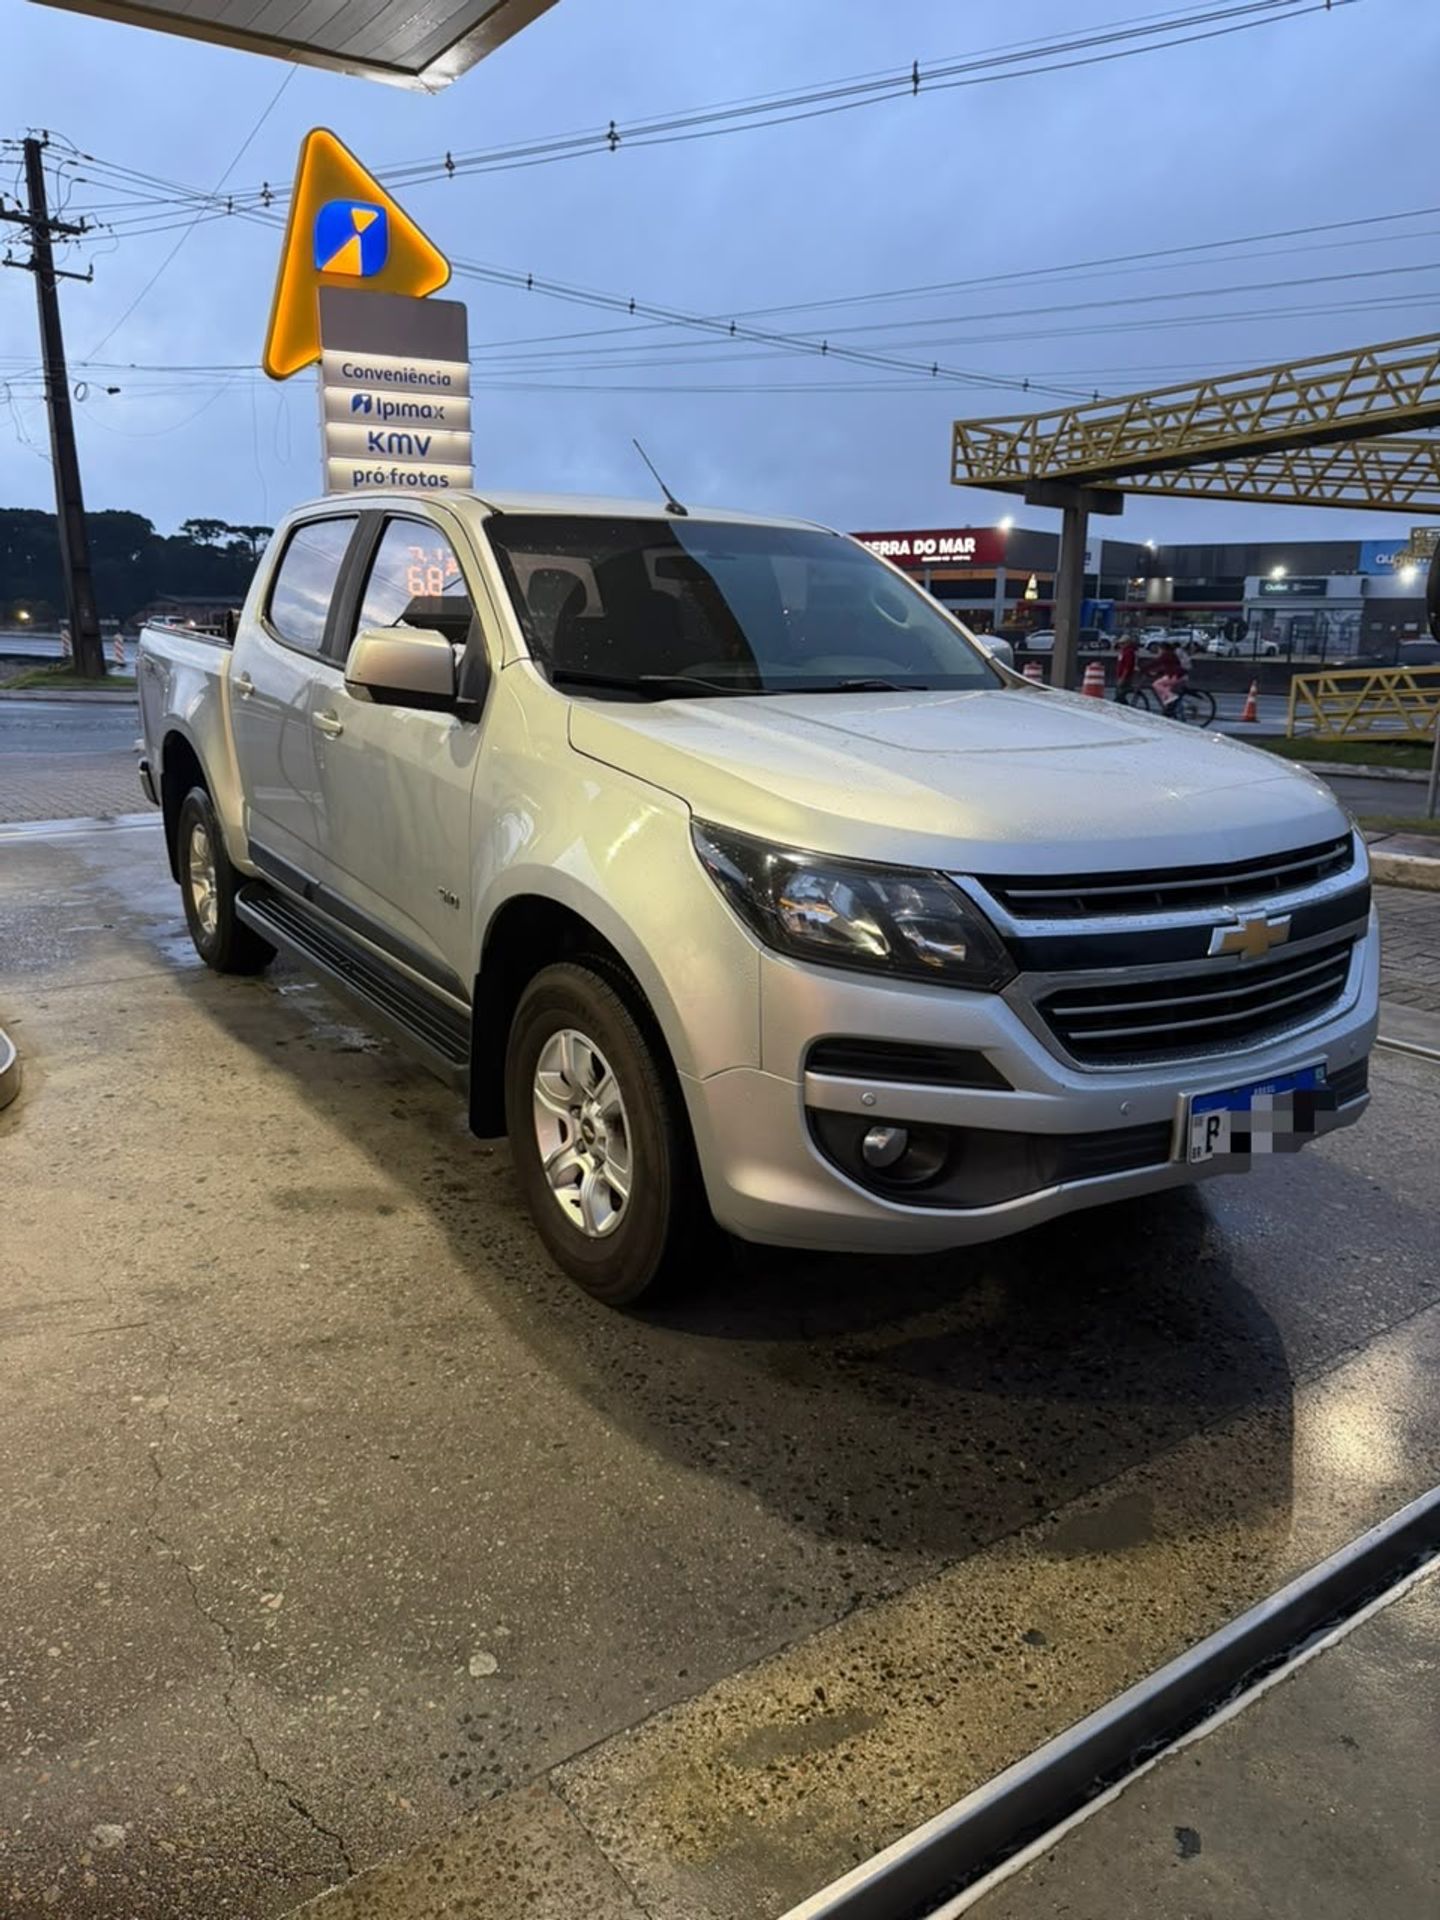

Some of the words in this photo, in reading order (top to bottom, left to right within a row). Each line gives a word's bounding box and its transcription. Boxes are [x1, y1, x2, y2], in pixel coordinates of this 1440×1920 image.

[341, 362, 451, 386] Conveniência
[376, 396, 445, 420] Ipimax
[368, 430, 432, 456] KMV
[913, 540, 936, 555] DO
[939, 538, 975, 553] MAR
